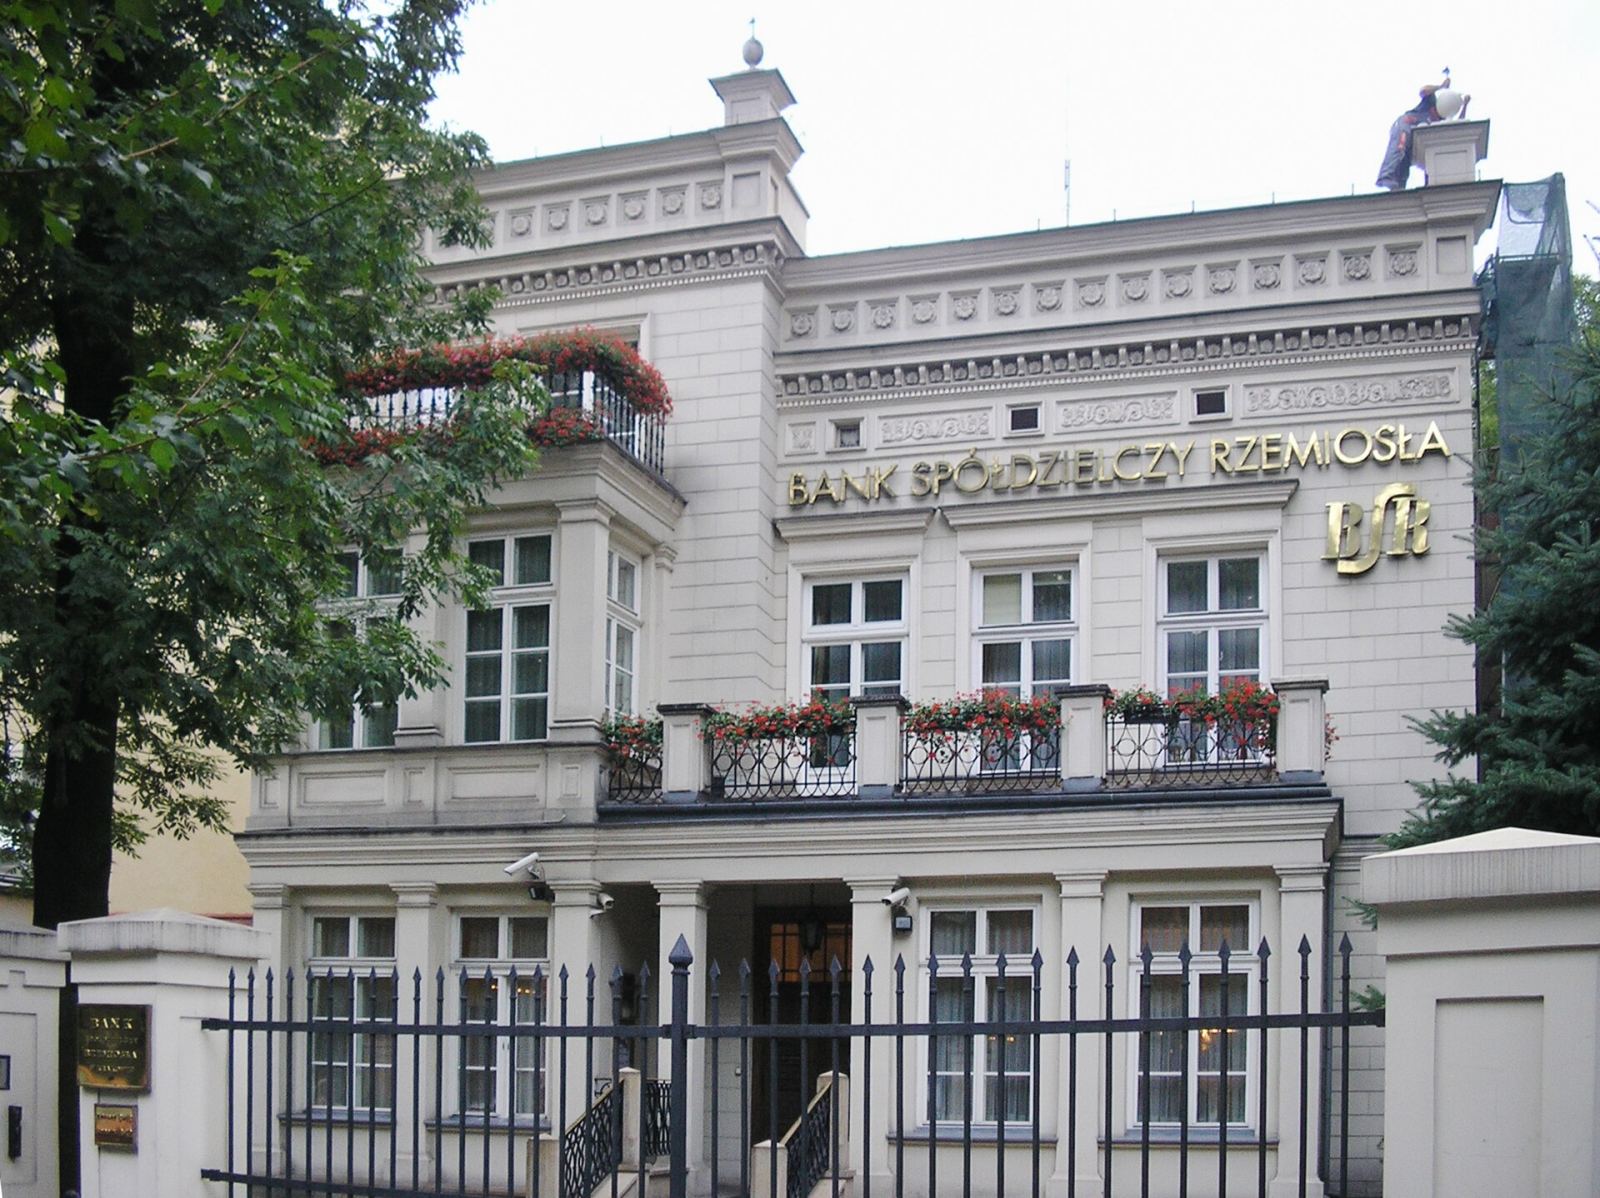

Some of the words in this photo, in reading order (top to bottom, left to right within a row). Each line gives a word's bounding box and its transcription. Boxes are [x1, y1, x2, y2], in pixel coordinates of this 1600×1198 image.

[788, 465, 896, 506] BANK
[911, 440, 1195, 497] SPÓŁDZIELCZY
[1210, 421, 1451, 474] RZEMIOSŁA
[90, 1017, 134, 1030] BANK
